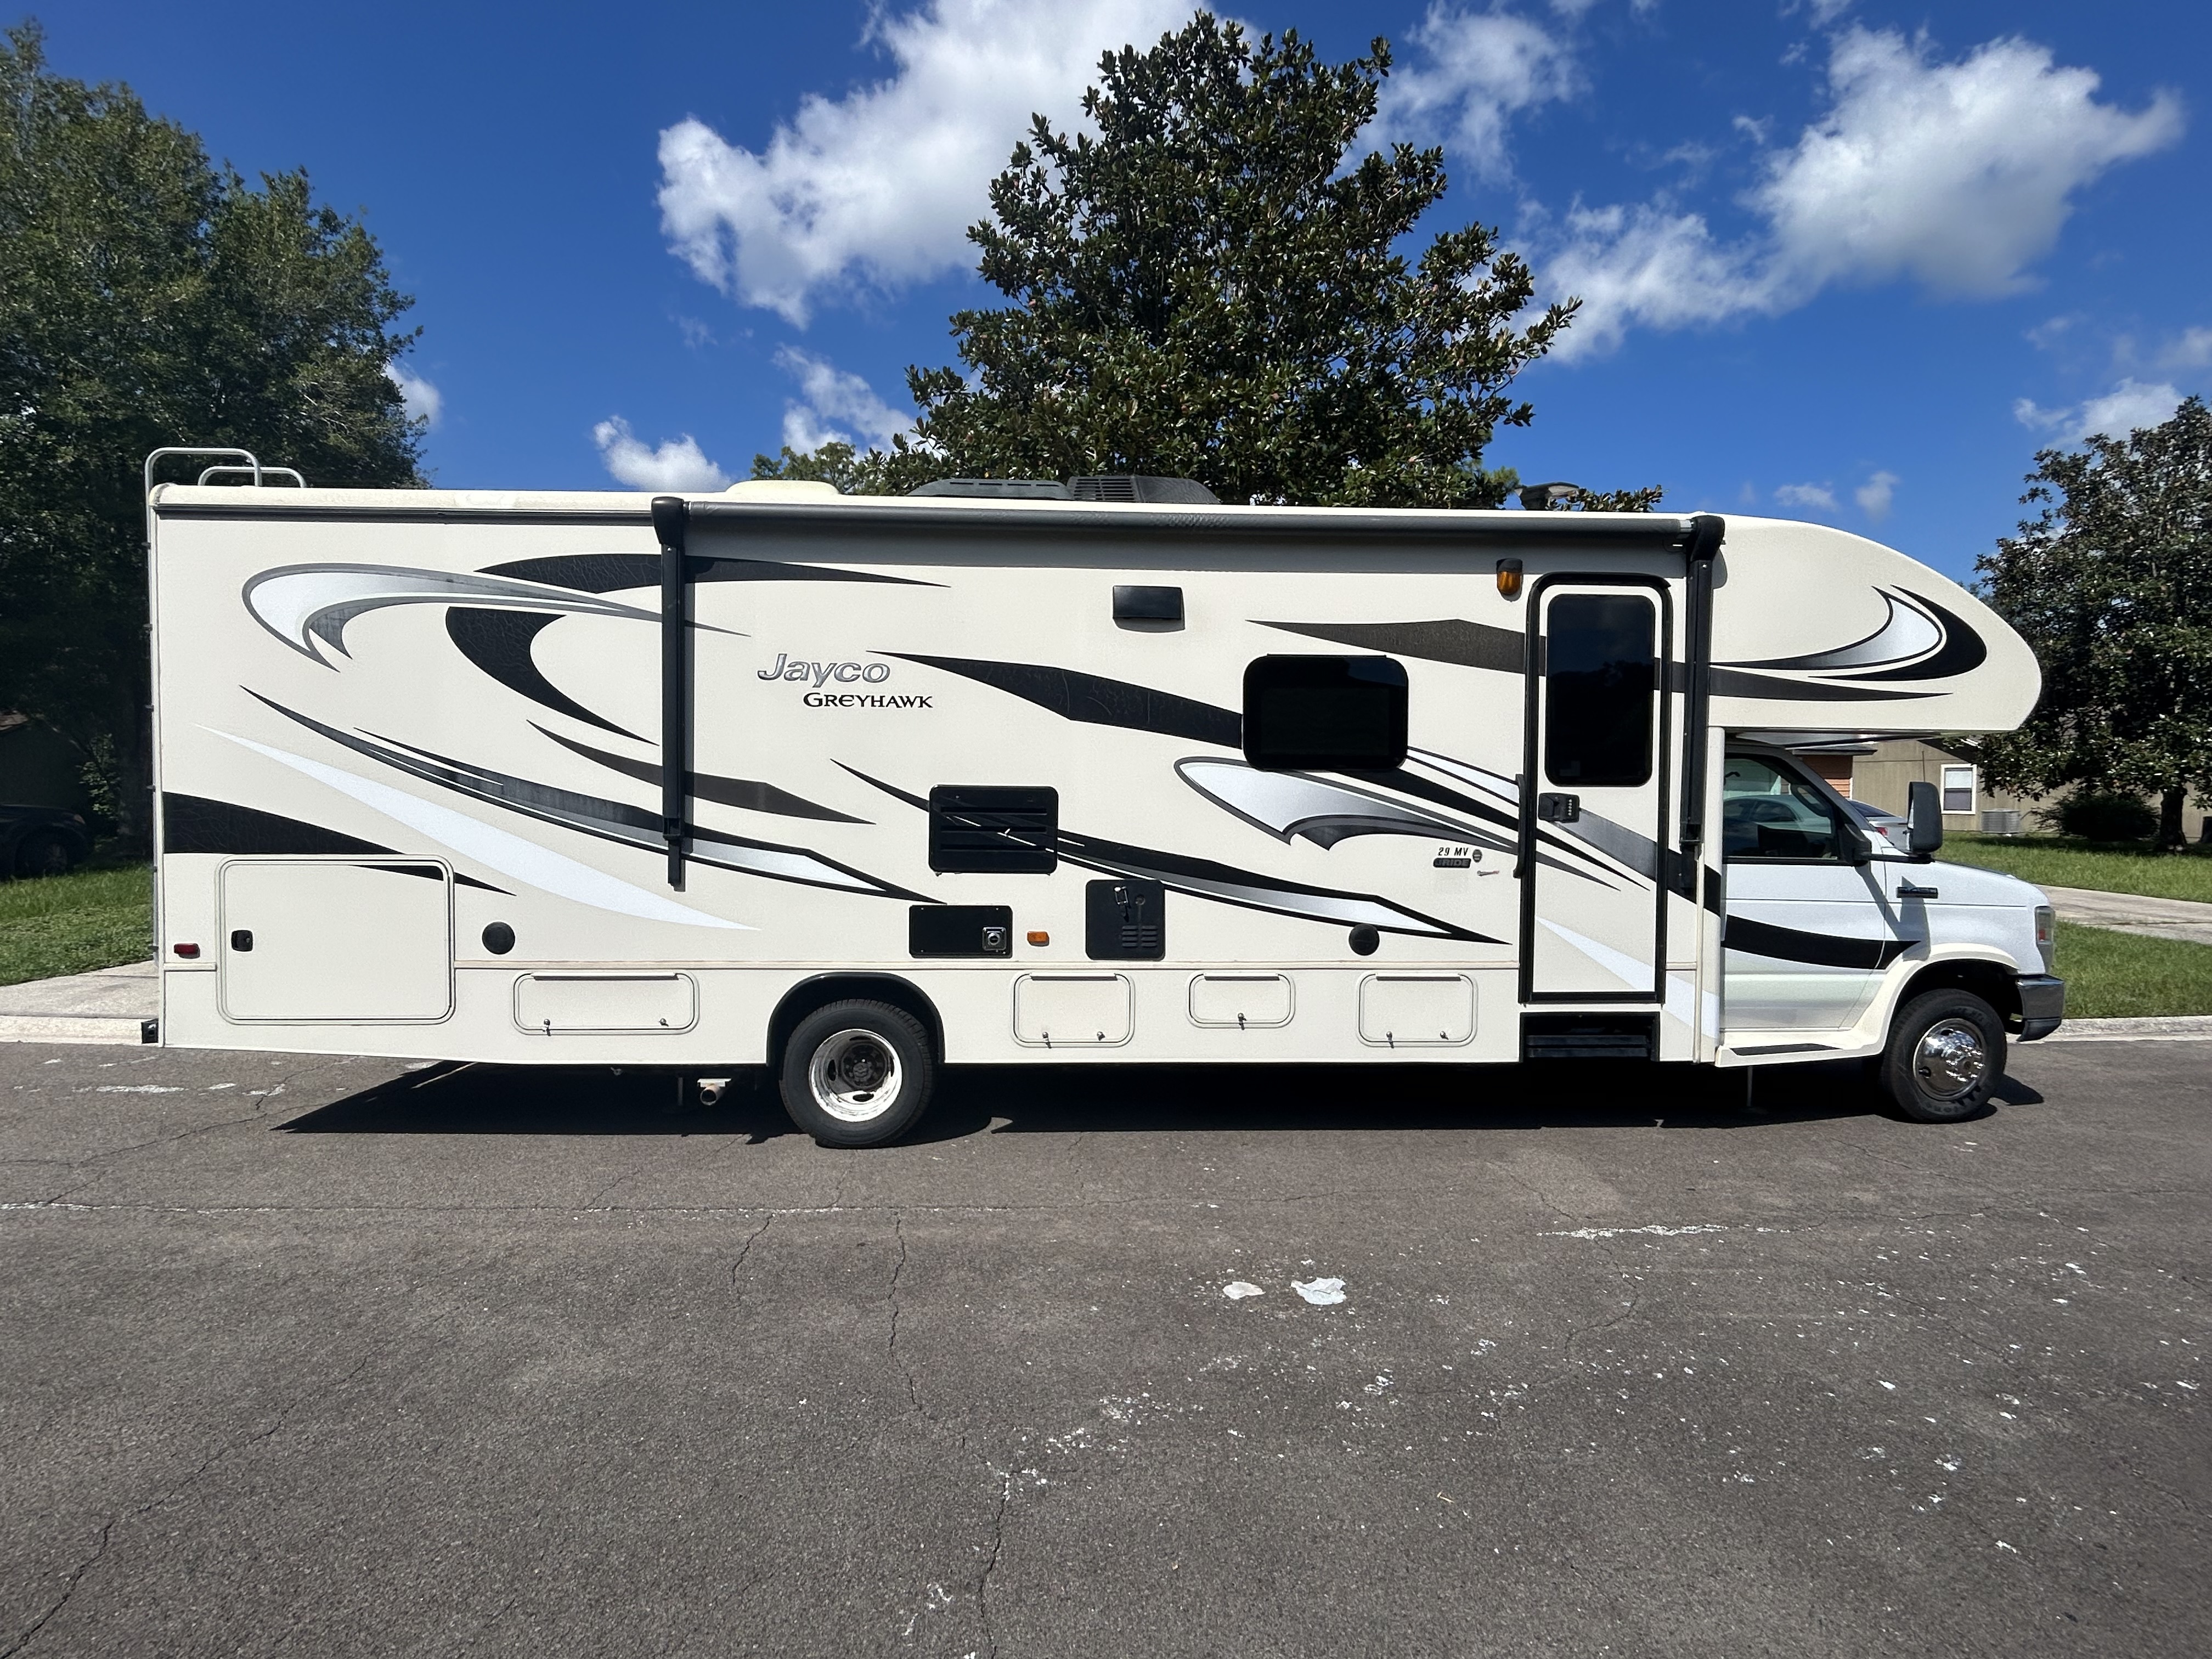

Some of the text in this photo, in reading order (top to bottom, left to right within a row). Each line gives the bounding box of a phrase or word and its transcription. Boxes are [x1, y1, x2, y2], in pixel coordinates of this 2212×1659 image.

[757, 653, 891, 688] Jayco
[1437, 847, 1469, 856] 29 MV
